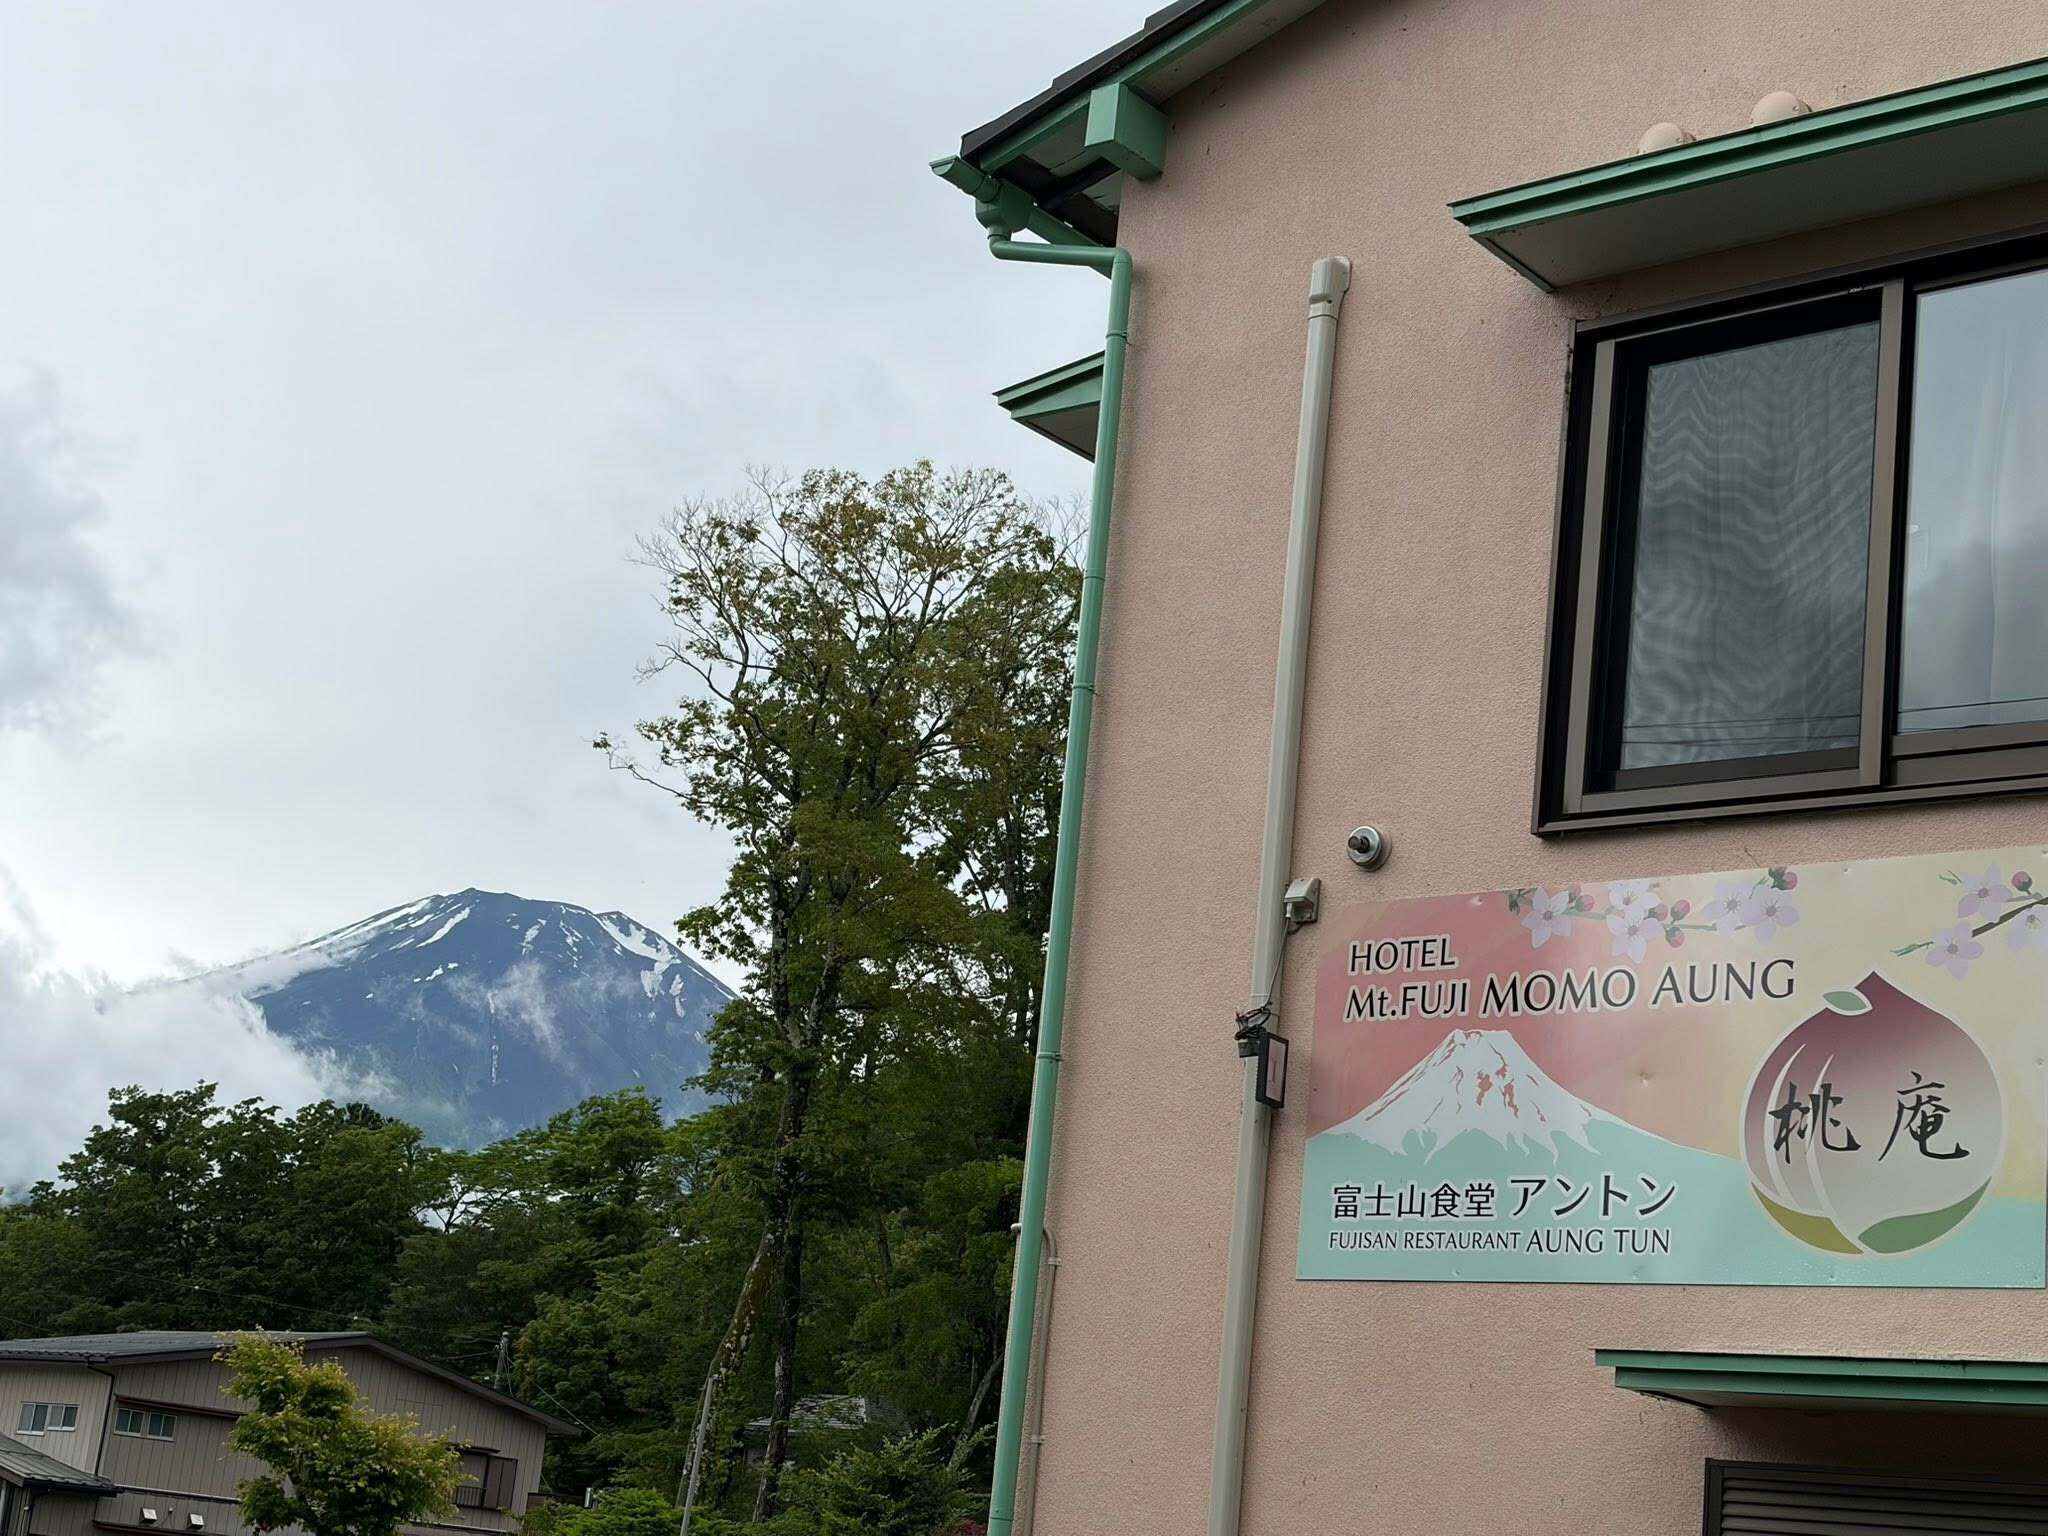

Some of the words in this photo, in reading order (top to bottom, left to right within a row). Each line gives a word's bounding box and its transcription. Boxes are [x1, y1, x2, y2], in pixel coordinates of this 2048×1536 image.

[1350, 937, 1456, 973] HOTEL
[1482, 967, 1637, 1015] MOMO
[1651, 959, 1797, 1006] AUNG
[1332, 1183, 1496, 1220] 富士山食堂
[1510, 1175, 1677, 1220] アントン
[1328, 1231, 1398, 1250] FUJISAN
[1403, 1231, 1521, 1252] RESTAURANT
[1526, 1228, 1606, 1254] AUNG
[1613, 1228, 1671, 1254] TUN
